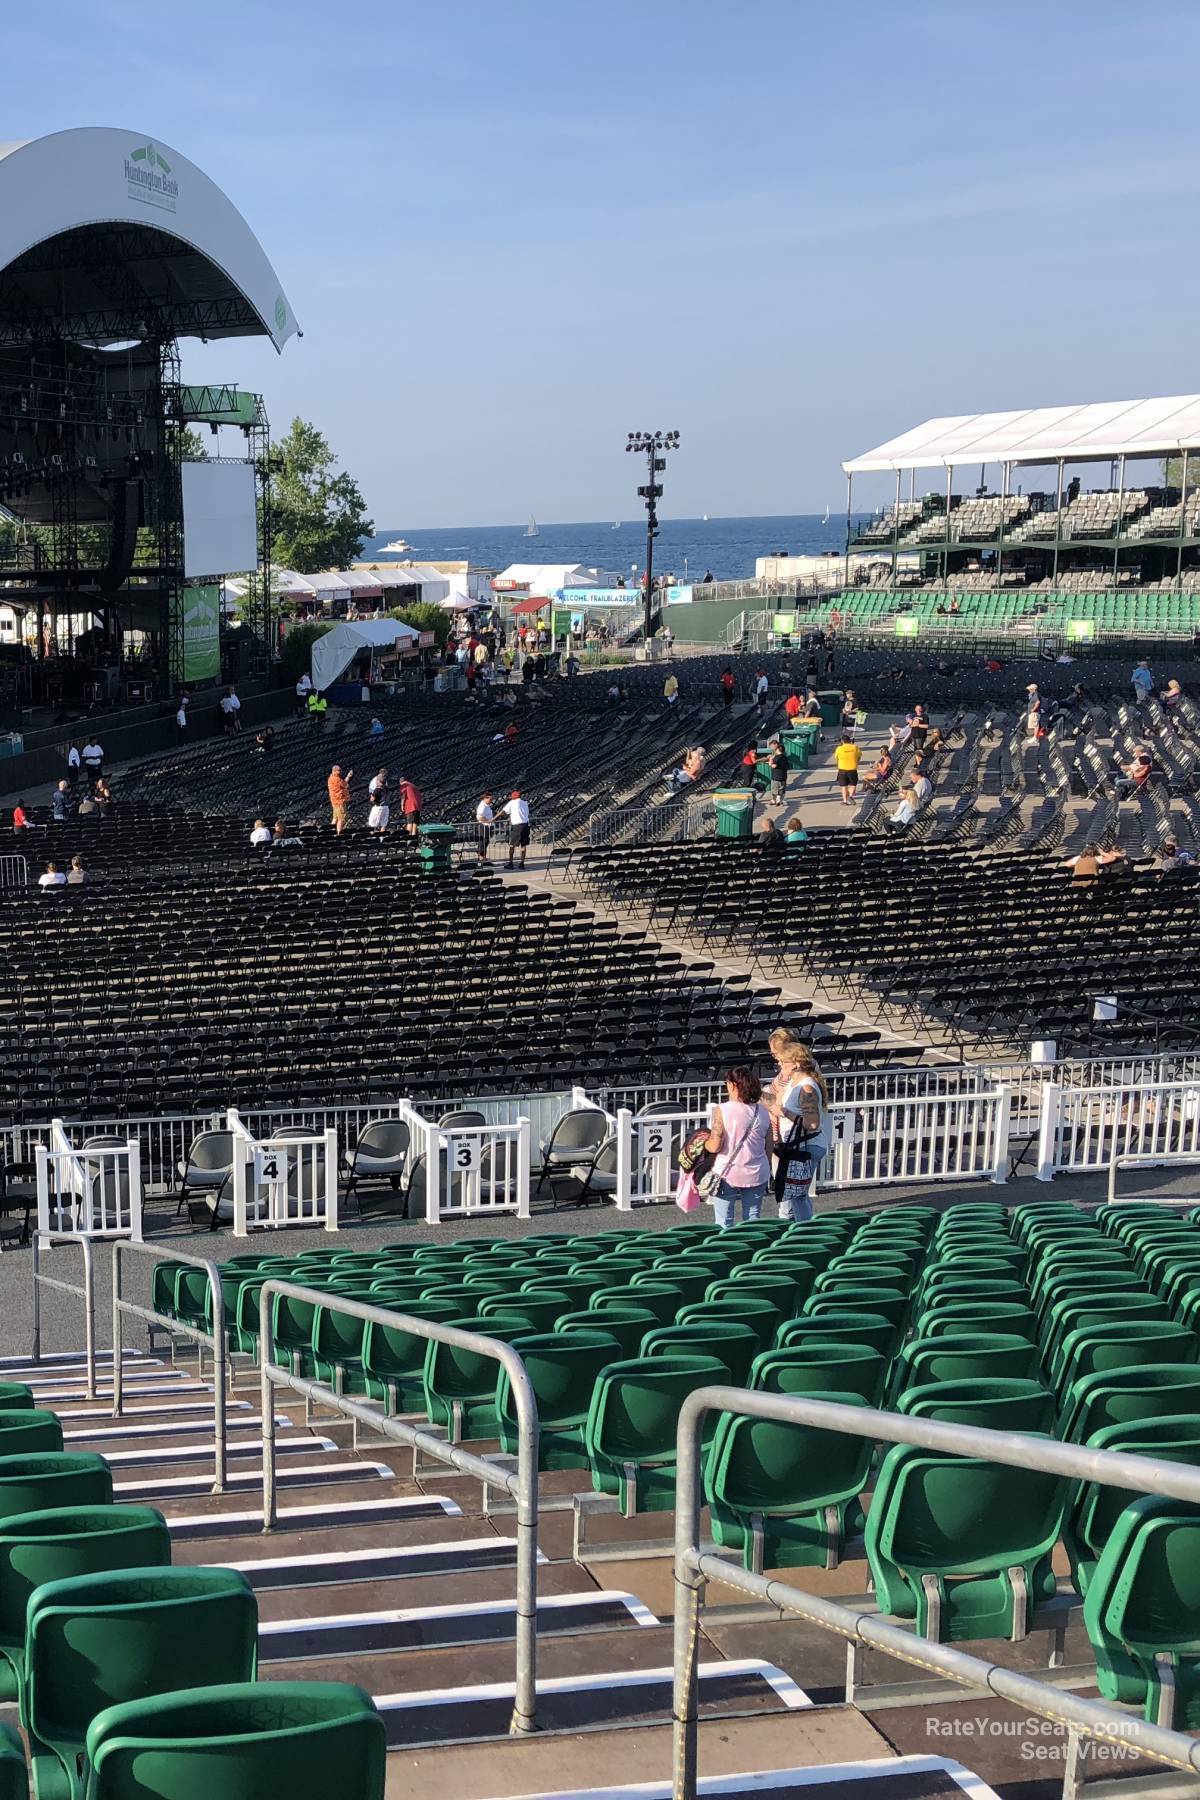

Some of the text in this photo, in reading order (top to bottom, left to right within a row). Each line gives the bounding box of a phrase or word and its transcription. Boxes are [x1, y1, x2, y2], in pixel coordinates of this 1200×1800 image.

[124, 160, 162, 191] Huntington
[162, 174, 178, 197] Bank
[590, 594, 634, 602] TRAILBLAZERS
[834, 1121, 845, 1139] 1
[648, 1135, 663, 1153] 2
[457, 1148, 473, 1168] 3
[262, 1161, 279, 1179] 4
